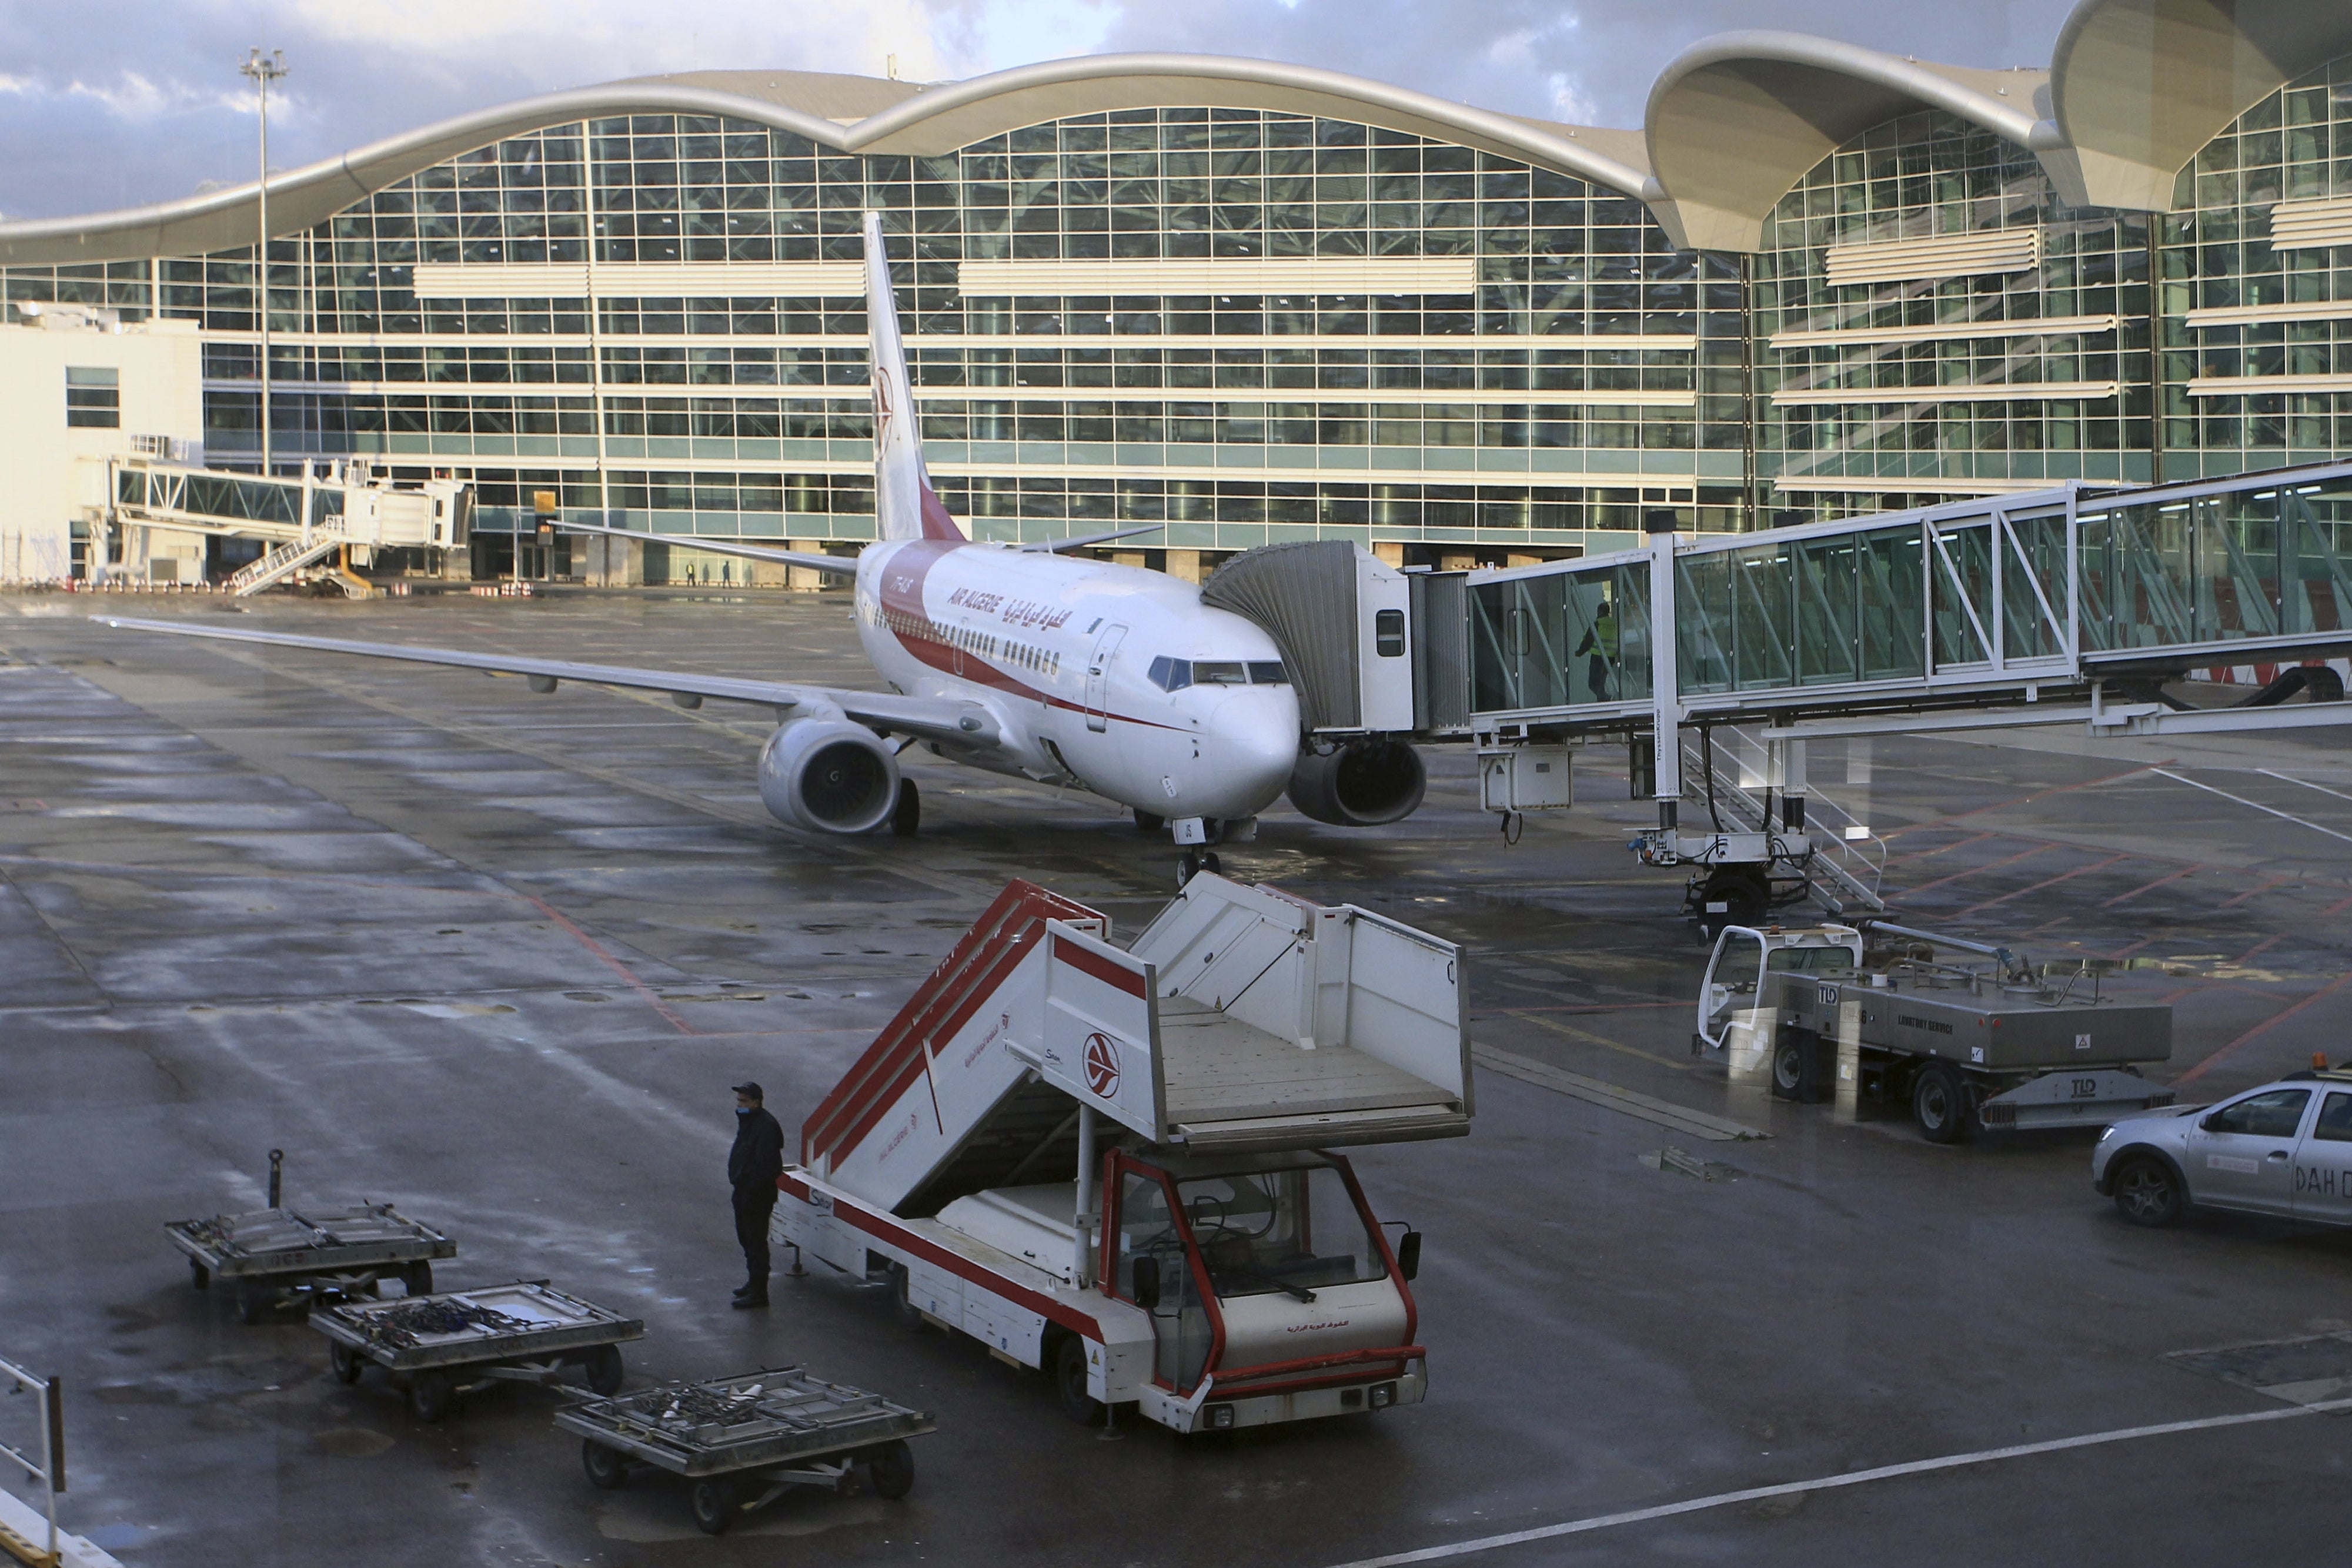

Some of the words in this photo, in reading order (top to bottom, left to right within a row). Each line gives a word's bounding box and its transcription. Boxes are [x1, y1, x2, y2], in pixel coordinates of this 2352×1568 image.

[947, 587, 969, 606] AIR
[1819, 986, 1838, 1004] TLD
[1898, 1014, 1927, 1030] LAVATORY
[1928, 1019, 1953, 1035] SERVICE
[2072, 1078, 2096, 1095] TLD
[2296, 1166, 2334, 1195] DAH
